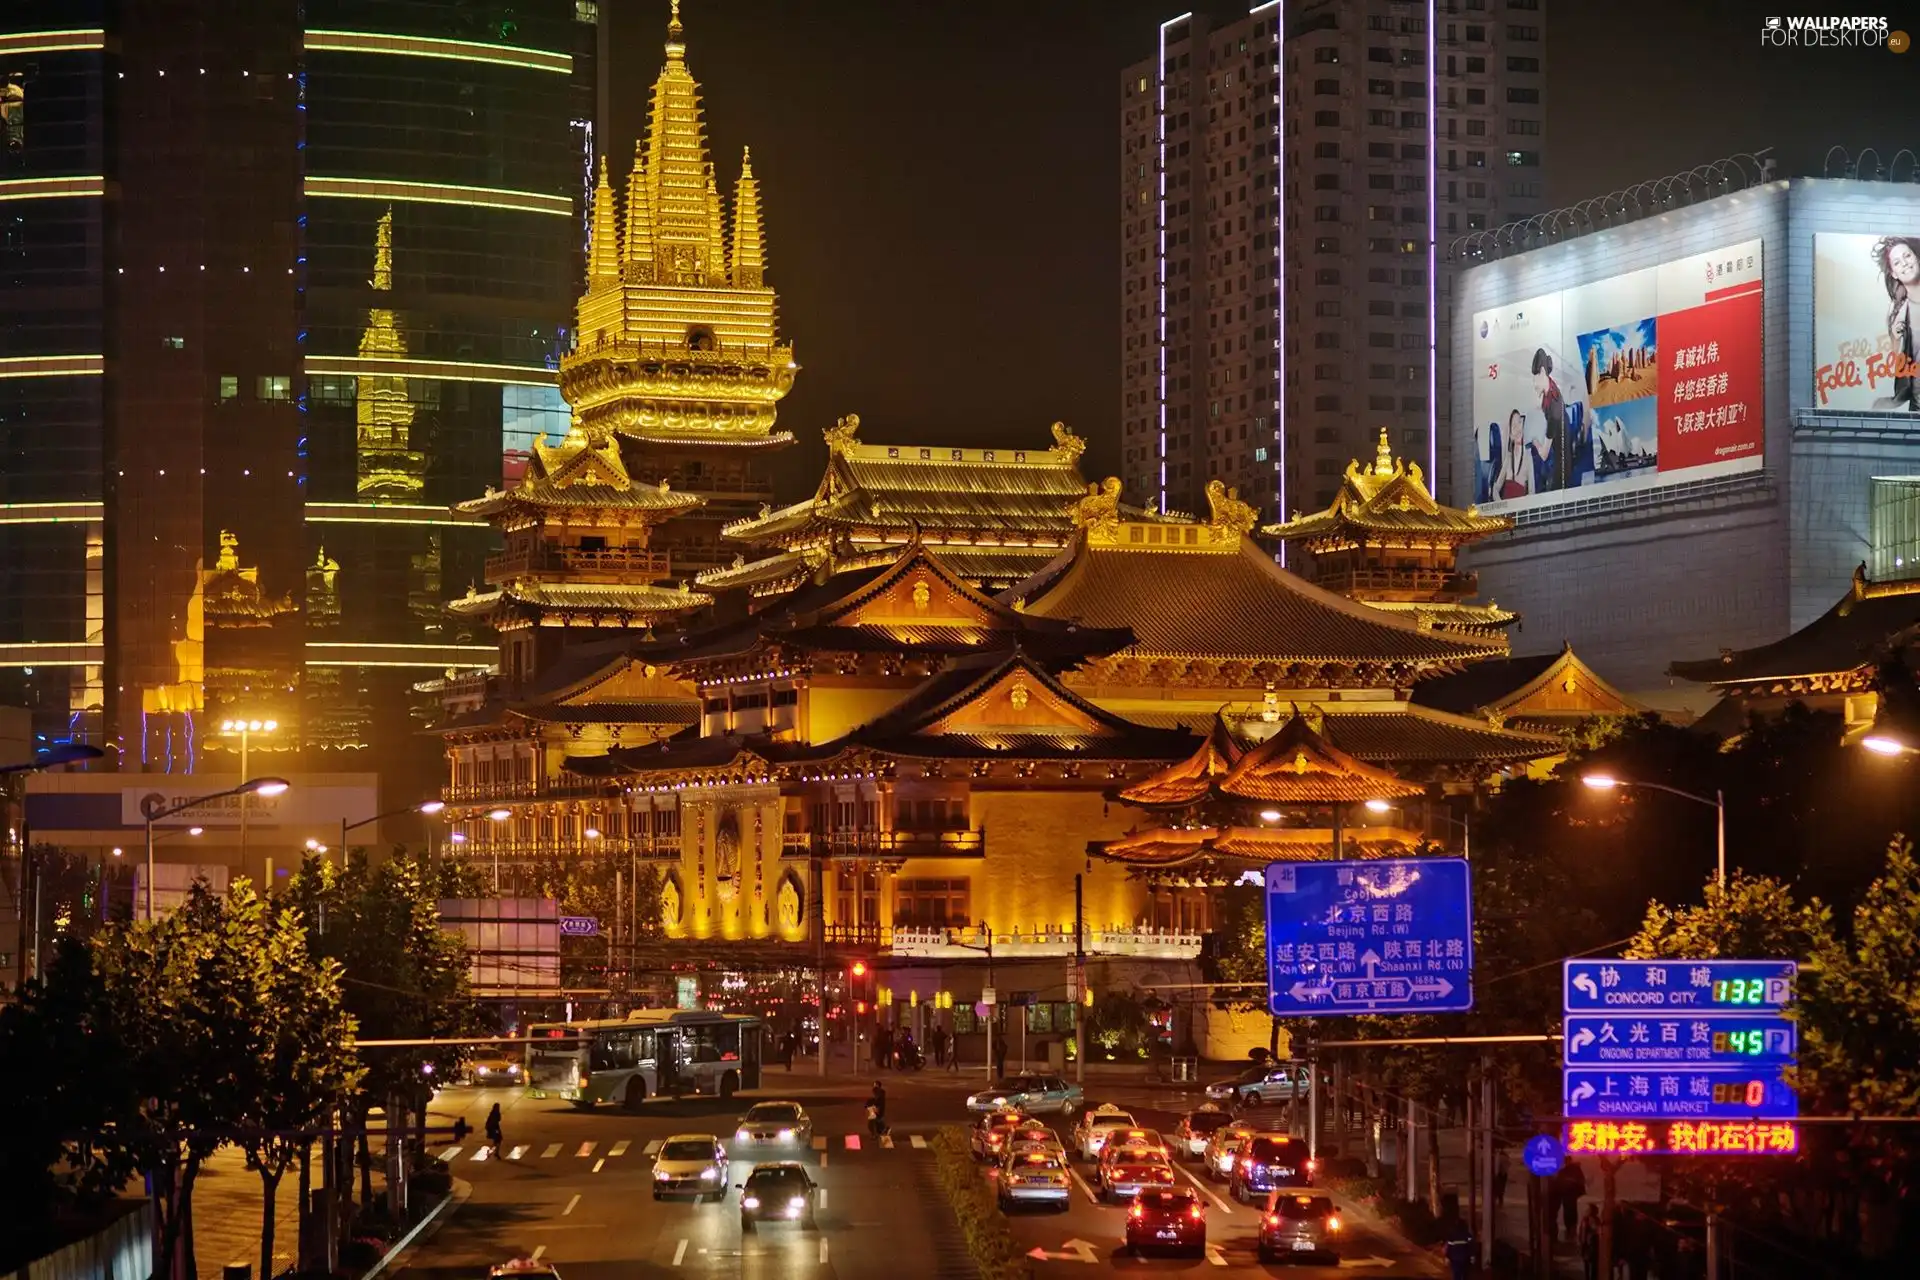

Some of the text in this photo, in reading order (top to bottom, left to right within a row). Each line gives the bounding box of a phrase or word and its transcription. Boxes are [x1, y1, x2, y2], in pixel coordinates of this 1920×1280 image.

[1673, 371, 1729, 403] 伴您经香港
[1816, 360, 1862, 405] Folli
[1326, 904, 1413, 923] 北京西路
[1328, 925, 1365, 939] Beijing
[1276, 941, 1357, 962] 延安西路
[1384, 939, 1464, 959] 陕西北路
[1380, 959, 1422, 972] Shaanxi
[1338, 980, 1405, 998] 南京西路
[1605, 991, 1697, 1004] CONCORD CITY
[1719, 978, 1764, 1004] 132
[1599, 1021, 1711, 1044] 久光百货
[1729, 1029, 1763, 1055] 45
[1636, 1047, 1684, 1059] DEPARTMENT
[1686, 1047, 1711, 1059] STORE
[1599, 1075, 1711, 1097] 上海商城
[1598, 1100, 1711, 1113] SHANGHAI MARKET
